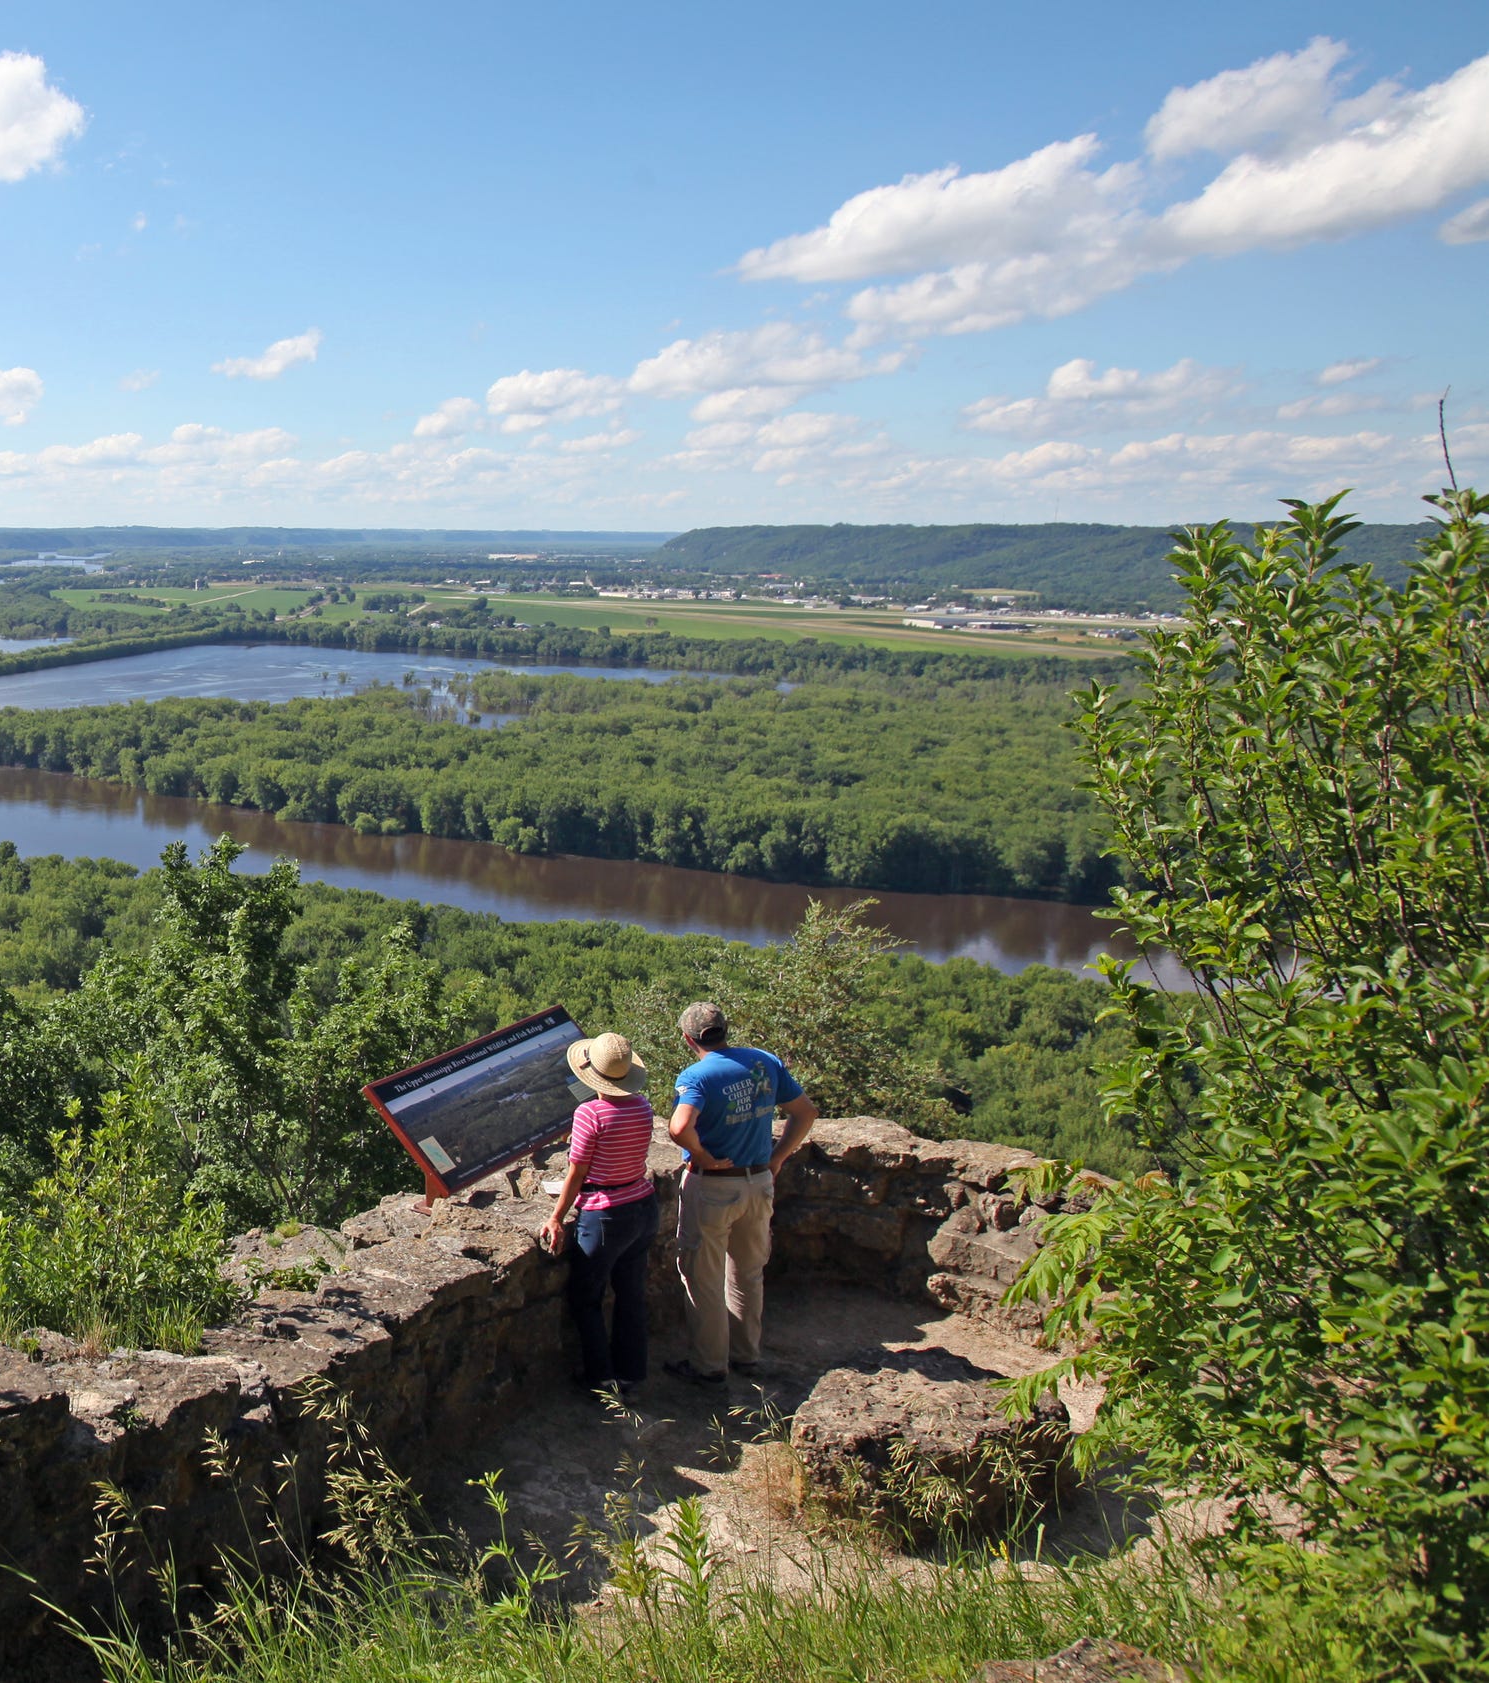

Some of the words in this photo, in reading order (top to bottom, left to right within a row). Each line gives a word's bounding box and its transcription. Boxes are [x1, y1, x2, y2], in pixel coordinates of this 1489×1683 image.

[394, 1085, 406, 1093] The
[405, 1077, 424, 1088] Upper
[422, 1064, 453, 1079] Mississippi
[451, 1058, 467, 1068] River
[466, 1047, 487, 1062] National
[486, 1039, 508, 1052] Wildlife
[507, 1034, 518, 1043] and
[515, 1030, 528, 1040] Fish
[525, 1024, 544, 1035] Refuge
[736, 1096, 752, 1106] FOR
[735, 1103, 752, 1114] OLD
